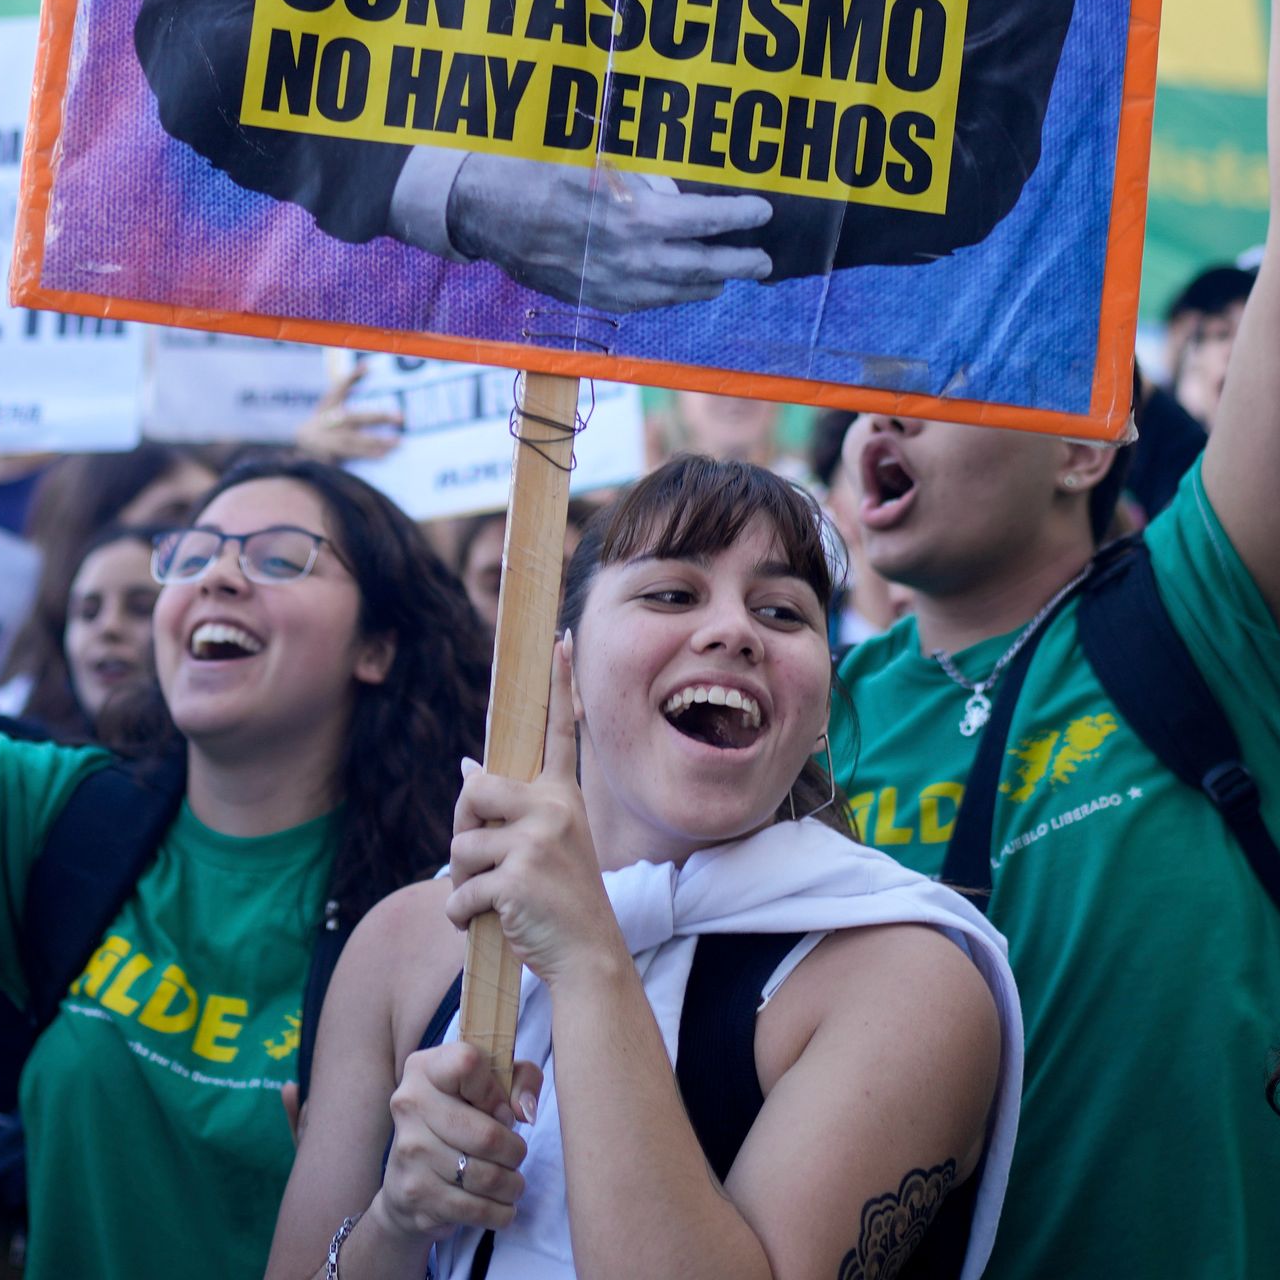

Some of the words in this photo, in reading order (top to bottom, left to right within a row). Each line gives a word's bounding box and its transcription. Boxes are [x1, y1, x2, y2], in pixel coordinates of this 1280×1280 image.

[260, 27, 371, 122] NO
[384, 45, 537, 141] HAY
[543, 65, 936, 196] DERECHOS
[1051, 793, 1123, 831] LIBERADO
[70, 934, 249, 1064] ALDE
